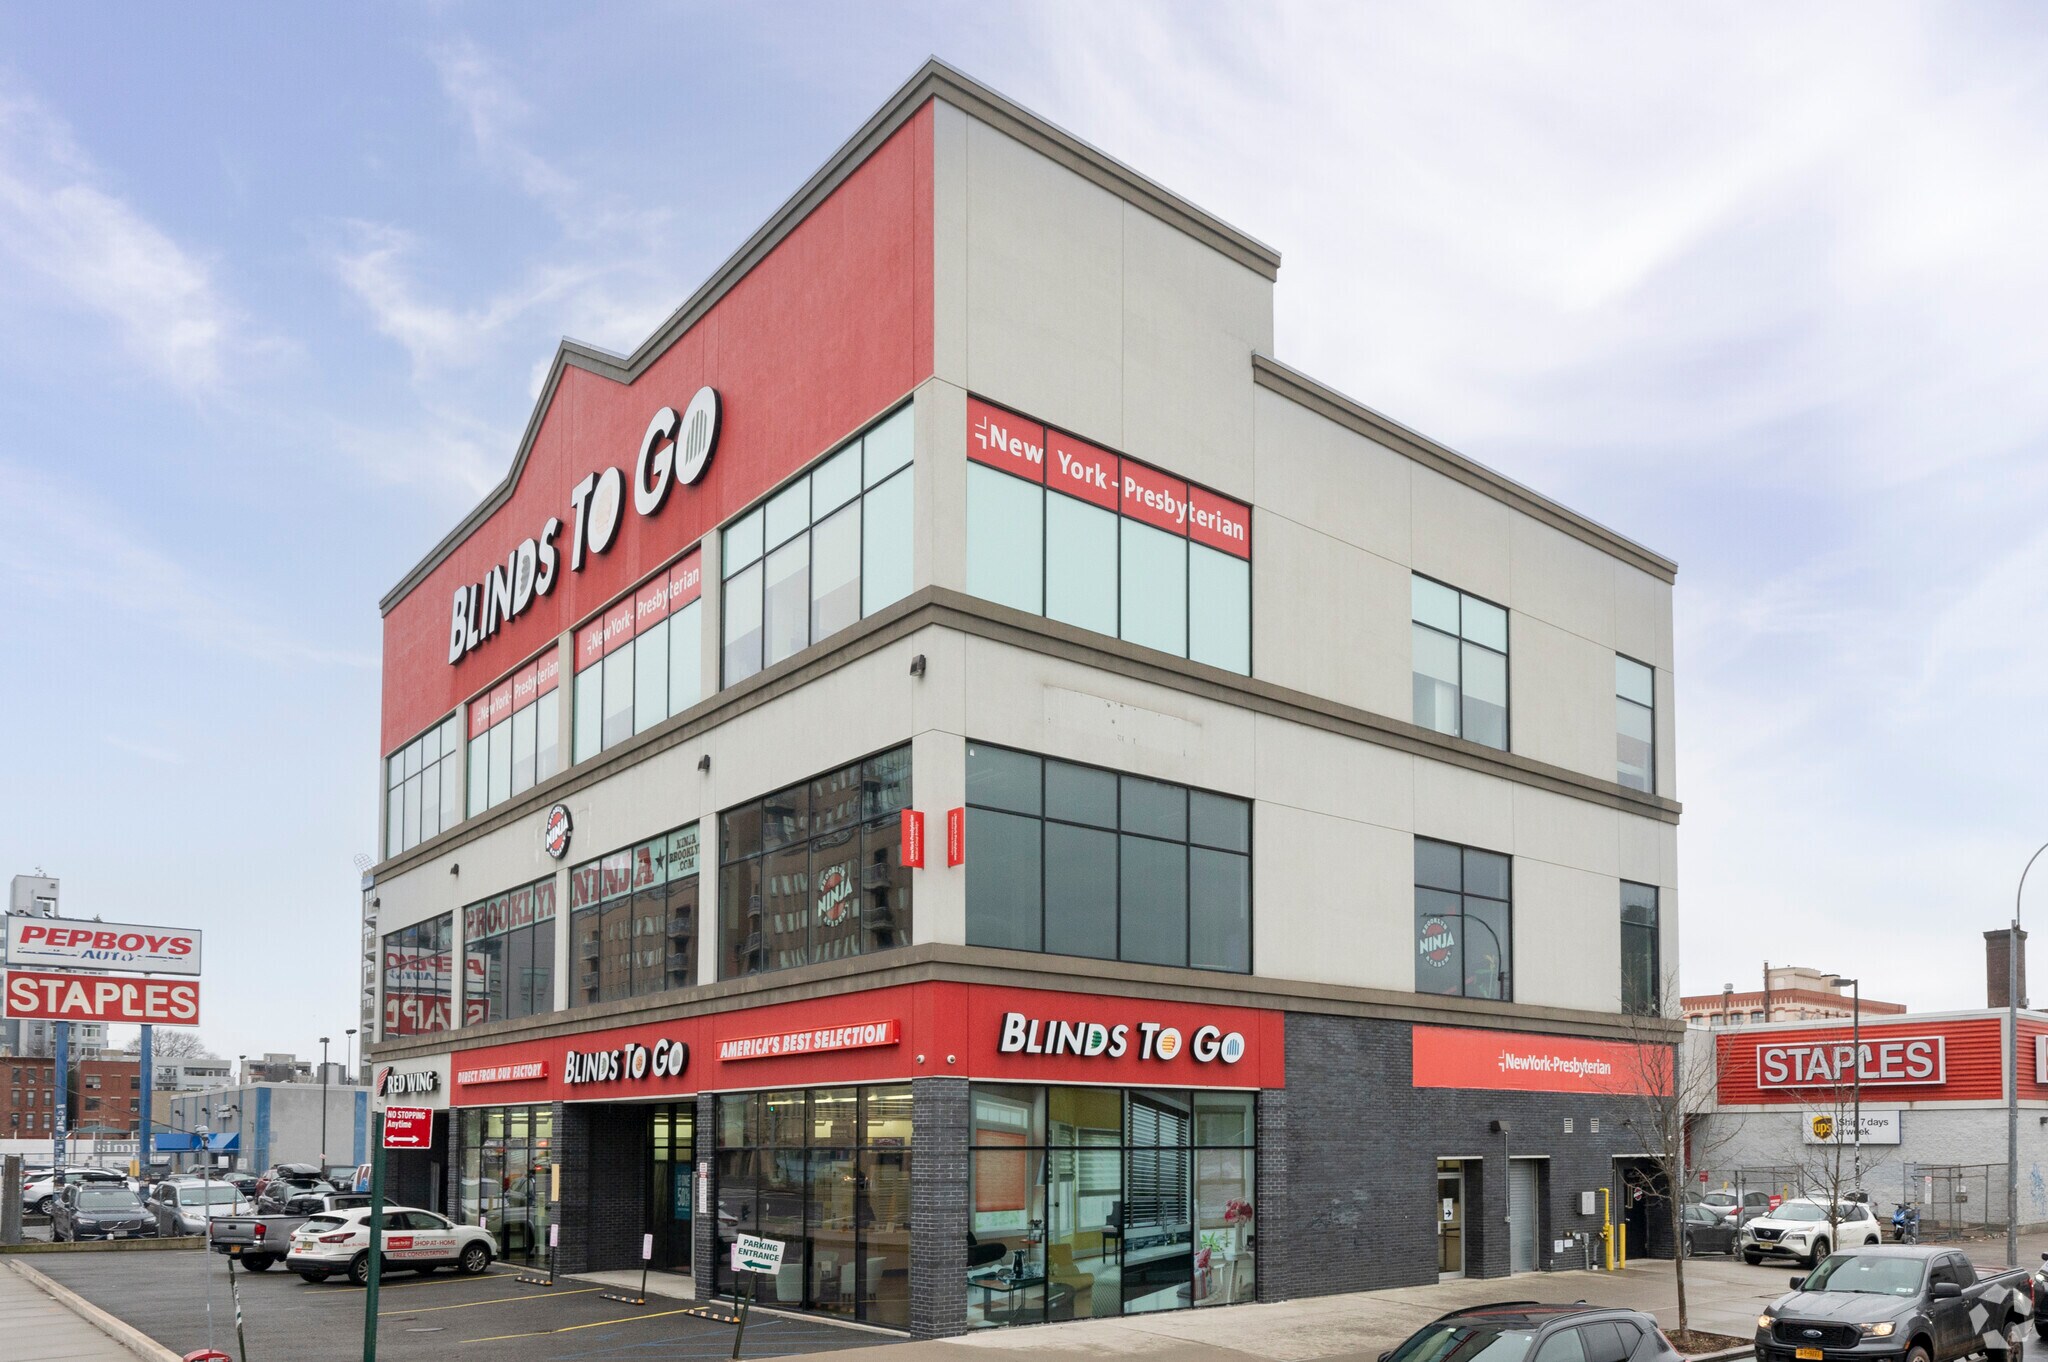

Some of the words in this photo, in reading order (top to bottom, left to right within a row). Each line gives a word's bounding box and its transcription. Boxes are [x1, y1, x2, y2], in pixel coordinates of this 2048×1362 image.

[990, 424, 1043, 465] New
[449, 517, 562, 665] BLINDS
[571, 466, 625, 572] TO
[634, 386, 721, 516] GO
[669, 843, 700, 863] BROOKLY
[573, 847, 654, 908] NINJA
[818, 877, 853, 917] NINJA
[19, 925, 193, 955] PEPBOYS
[1420, 931, 1455, 954] NINJA
[9, 977, 197, 1019] STAPLES
[720, 1036, 780, 1059] AMERICA'S
[783, 1032, 812, 1052] BEST
[814, 1023, 887, 1049] SELECTION
[1000, 1012, 1129, 1058] BLINDS
[1139, 1022, 1182, 1061] TO
[1193, 1025, 1245, 1064] GO
[457, 1070, 479, 1083] DIRECT
[479, 1068, 496, 1081] FROM
[497, 1066, 511, 1080] OUR
[513, 1063, 542, 1078] FACTORY
[563, 1049, 619, 1084] BLINDS
[625, 1043, 647, 1079] TO
[652, 1038, 684, 1077] GO
[1764, 1041, 1933, 1083] STAPLES
[387, 1074, 405, 1094] RED
[407, 1071, 433, 1092] WING
[387, 1110, 397, 1119] NO
[397, 1111, 426, 1120] STOPPING
[387, 1120, 412, 1130] Anytime
[1860, 1118, 1866, 1126] 7
[1867, 1118, 1889, 1127] days
[1814, 1122, 1832, 1137] ups
[738, 1247, 780, 1262] ENTRANCE
[743, 1239, 778, 1252] PARKING
